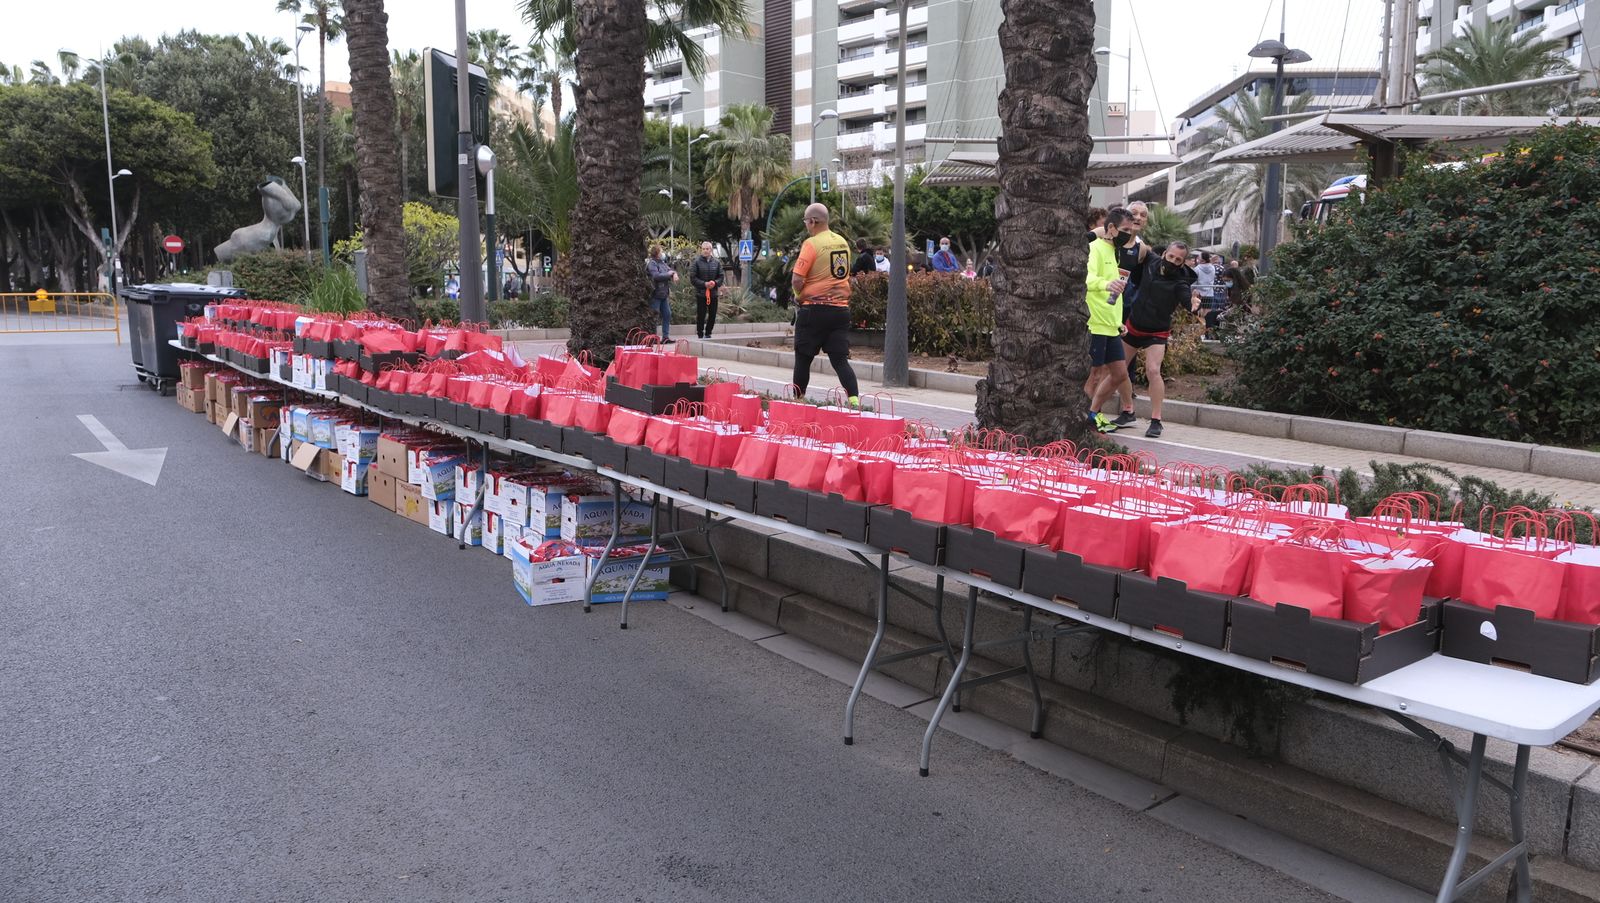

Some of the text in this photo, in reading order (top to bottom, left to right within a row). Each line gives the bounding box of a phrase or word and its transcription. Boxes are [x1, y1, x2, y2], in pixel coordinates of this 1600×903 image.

[583, 510, 608, 520] AQUA
[538, 562, 556, 571] AQUA
[598, 564, 624, 576] AQUA
